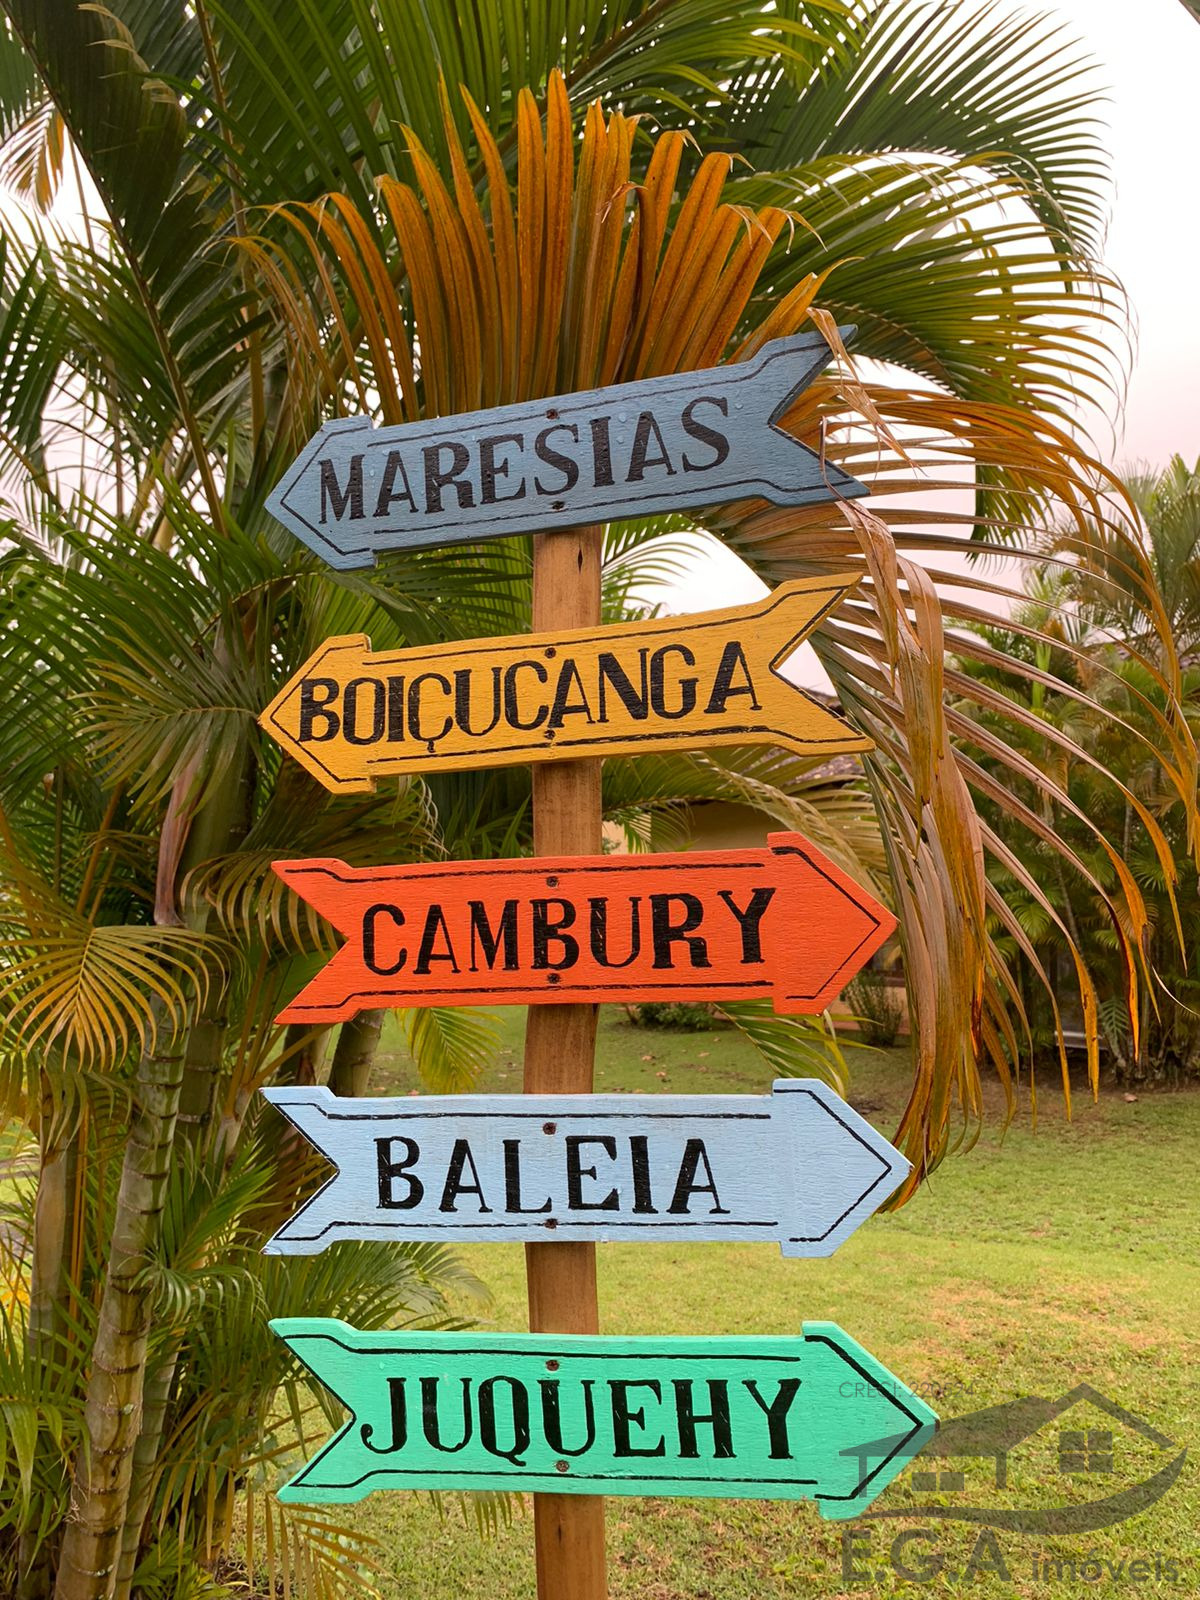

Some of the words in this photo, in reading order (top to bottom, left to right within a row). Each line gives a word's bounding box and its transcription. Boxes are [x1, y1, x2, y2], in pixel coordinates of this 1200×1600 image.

[319, 398, 730, 524] MARESIAS
[299, 641, 762, 753] BOIÇUCANGA
[362, 887, 776, 976] CAMBURY
[374, 1136, 731, 1214] BALEIA
[361, 1375, 801, 1466] JUQUEHY
